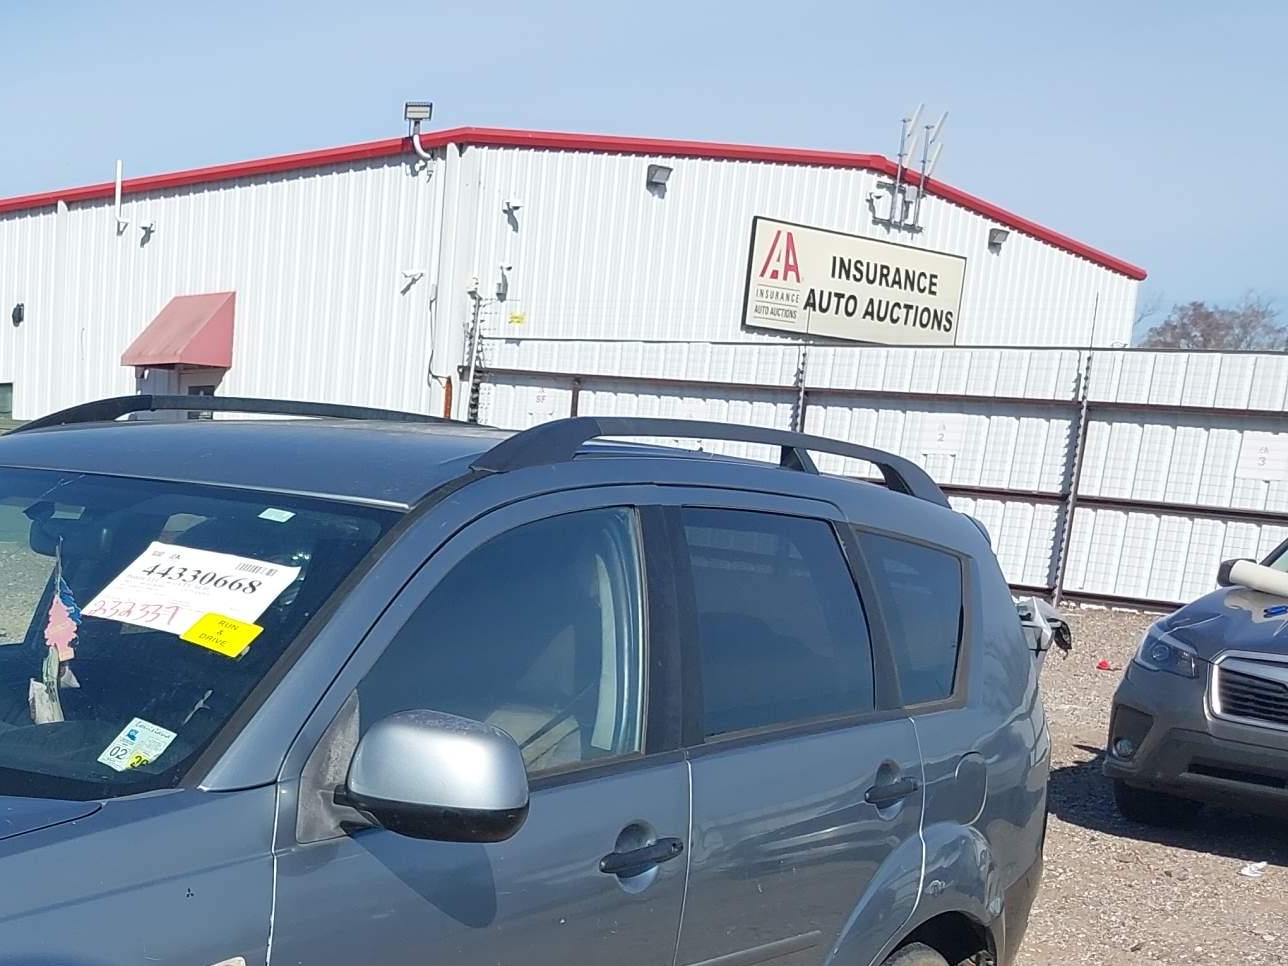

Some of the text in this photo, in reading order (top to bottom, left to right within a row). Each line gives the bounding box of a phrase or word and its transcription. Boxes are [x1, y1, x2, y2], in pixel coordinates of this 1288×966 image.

[831, 255, 938, 296] INSURANCE
[755, 287, 800, 303] INSURANCE
[754, 304, 798, 319] AUTO AUCTIONS
[803, 287, 953, 333] AUTO AUCTIONS
[142, 563, 262, 594] 44330668
[218, 619, 240, 631] RUN
[198, 633, 227, 647] DRIVE
[110, 746, 128, 760] 02
